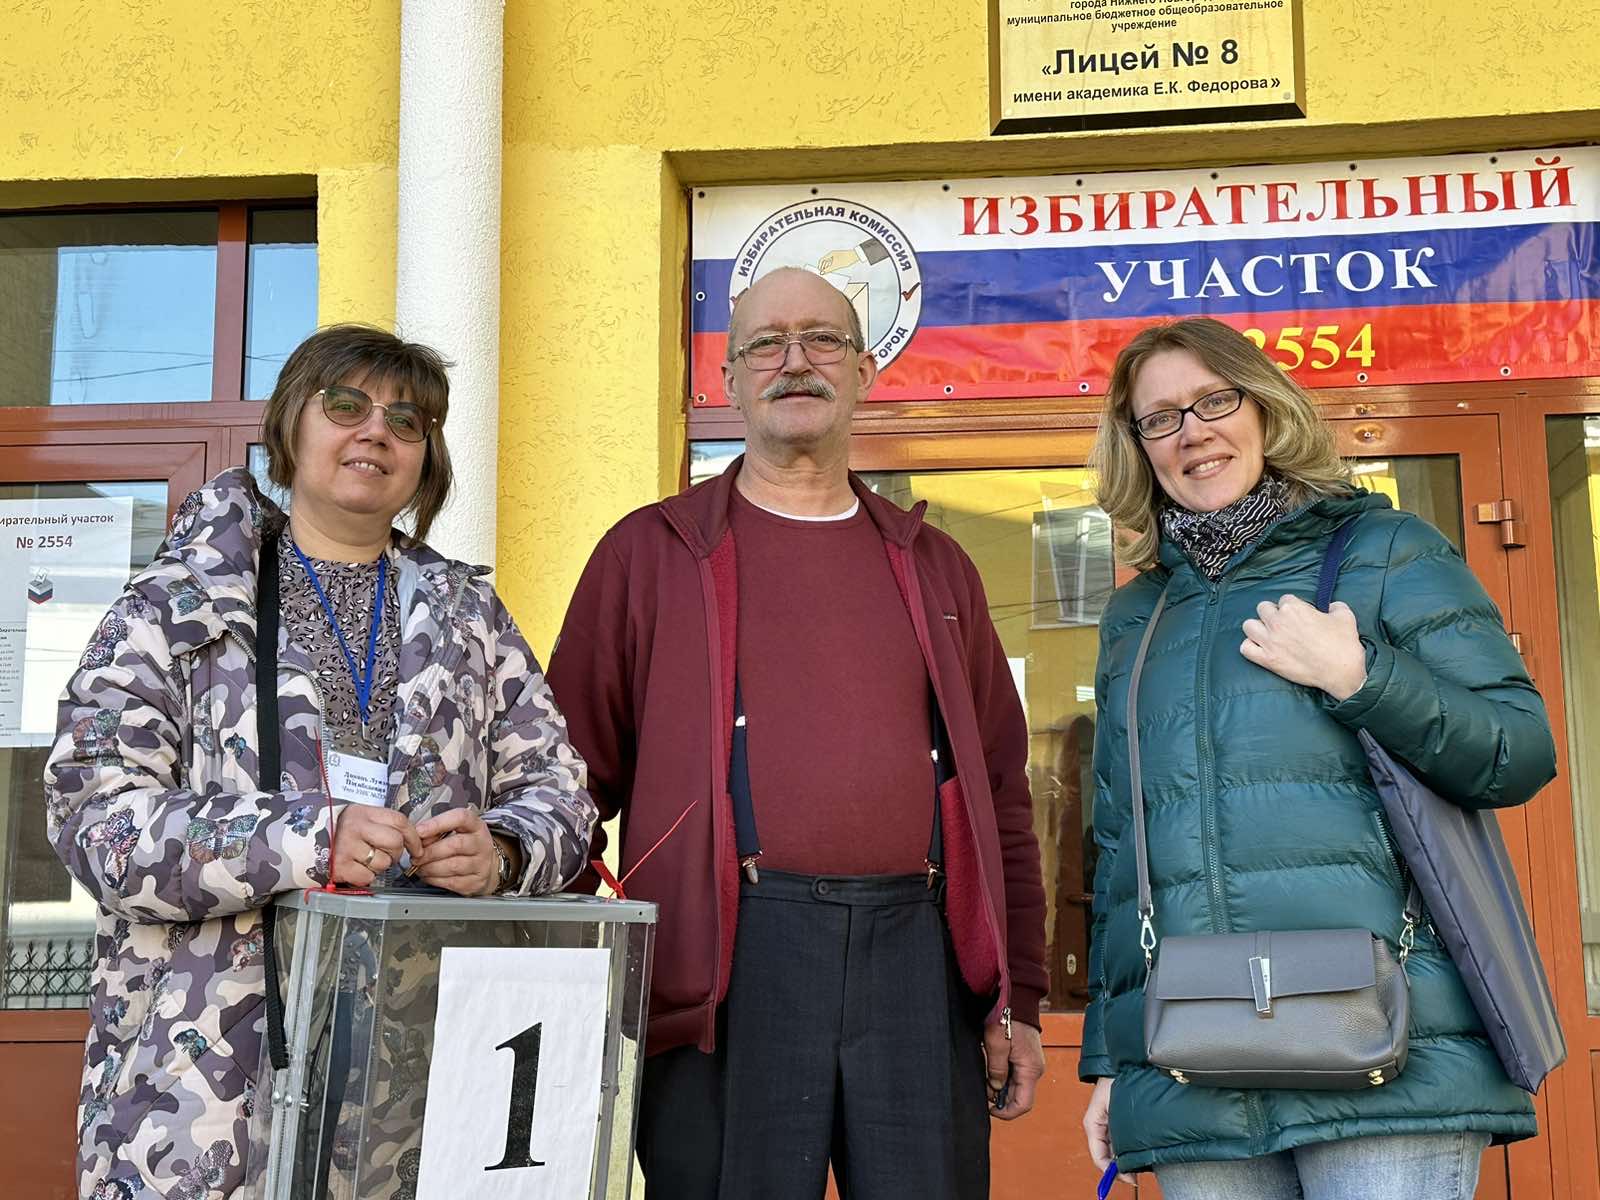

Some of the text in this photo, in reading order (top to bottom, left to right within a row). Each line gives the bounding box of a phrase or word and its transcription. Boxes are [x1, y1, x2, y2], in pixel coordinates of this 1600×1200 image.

[1007, 0, 1284, 27] муниципальное бюджетное общеобразовательное
[1071, 0, 1107, 10] города
[1111, 19, 1177, 33] учреждение
[1042, 39, 1239, 75] «Лицей № 8
[1013, 78, 1281, 103] имени академика Е.К. Федорова»
[958, 156, 1577, 236] ИЗБИРАТЕЛЬНЫЙ
[738, 205, 913, 278] ИЗБИРАТЕЛЬНАЯ КОМИССИЯ
[1094, 247, 1439, 303] УЧАСТОК
[874, 326, 909, 365] ОРОД
[71, 514, 114, 526] участок
[16, 535, 73, 549] № 2554
[484, 1022, 545, 1171] 1
